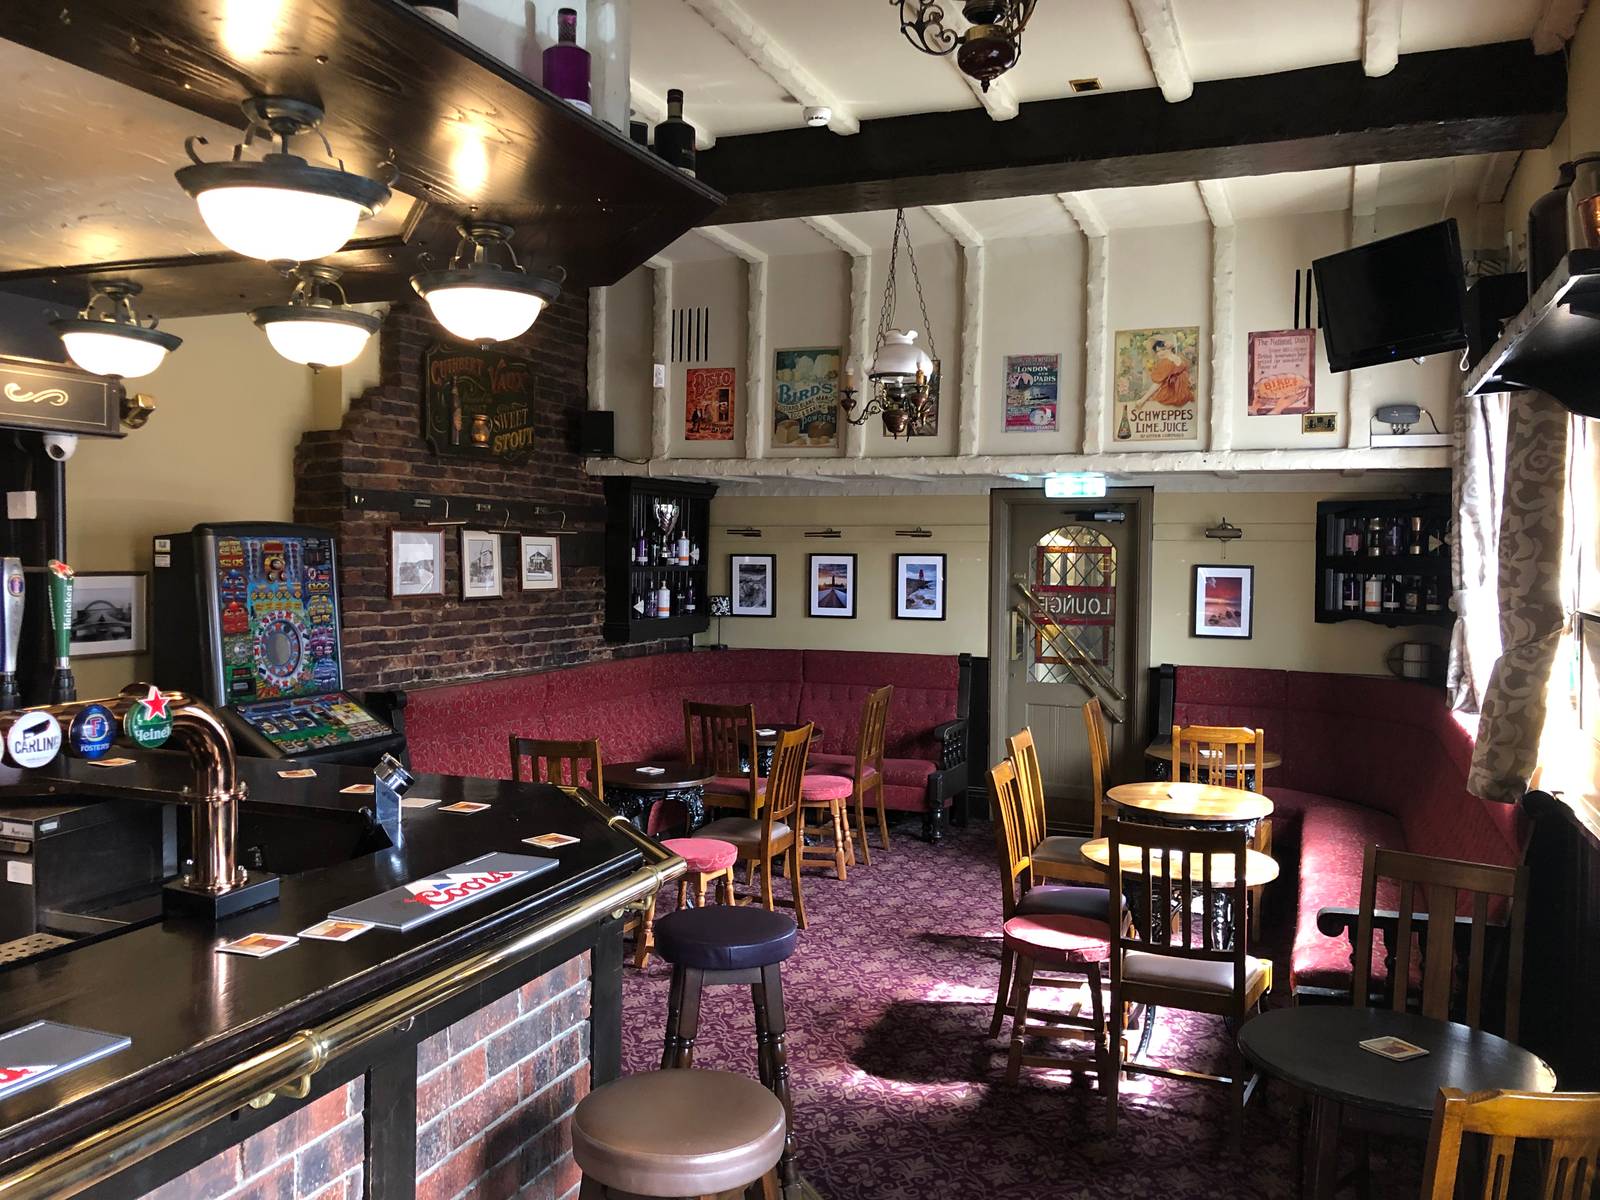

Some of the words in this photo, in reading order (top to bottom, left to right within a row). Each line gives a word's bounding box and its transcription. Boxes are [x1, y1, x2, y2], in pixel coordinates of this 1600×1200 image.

[779, 382, 834, 404] BIRD'S
[1130, 408, 1194, 422] SCHWEPPES
[1136, 422, 1160, 433] LIME
[1159, 421, 1188, 433] JUICE
[494, 428, 535, 453] STOUT
[63, 585, 73, 630] Heineken
[403, 869, 514, 907] Coors
